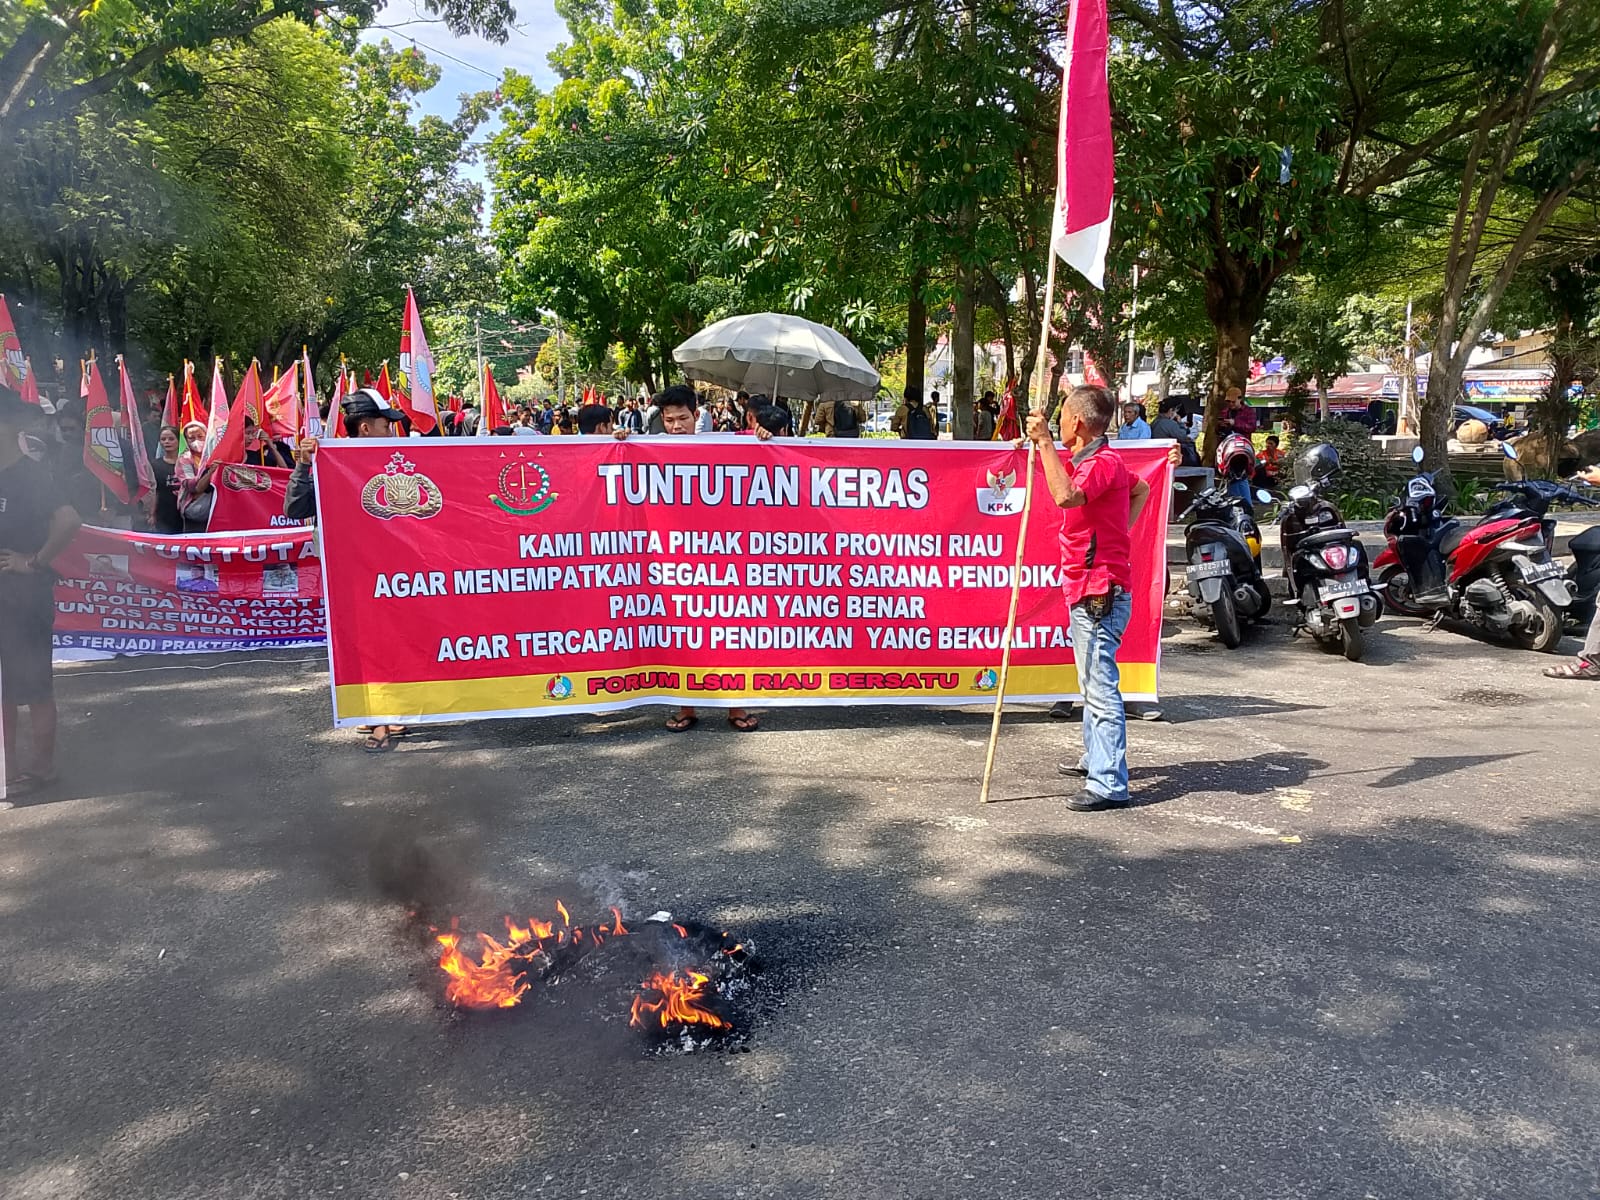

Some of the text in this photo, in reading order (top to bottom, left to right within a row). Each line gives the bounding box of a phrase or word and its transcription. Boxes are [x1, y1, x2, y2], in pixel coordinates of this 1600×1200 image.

[598, 464, 930, 510] TUNTUTAN KERAS
[987, 502, 1013, 512] KPK
[519, 530, 1003, 559] KAMI MINTA PIHAK DISDIK PROVINSI RIAU
[373, 571, 448, 599] AGAR
[453, 562, 641, 595] MENEMPATKAN
[647, 562, 740, 587] SEGALA
[746, 563, 843, 587] BENTUK
[848, 564, 943, 588] SARANA
[85, 592, 174, 609] (POLDA
[218, 598, 312, 608] APARAT
[609, 594, 926, 619] PADA TUJUAN YANG BENAR
[55, 602, 142, 618] UNTAS
[150, 610, 234, 625] SEMUA
[103, 617, 177, 632] DINAS
[80, 636, 156, 651] TERJADI
[162, 639, 246, 650] PRAKTEK
[437, 634, 510, 662] AGAR
[515, 627, 634, 656] TERCAPAI
[638, 625, 703, 649] MUTU
[710, 626, 853, 650] PENDIDIKAN
[866, 626, 931, 650] YANG
[587, 672, 960, 695] FORUM LSM RIAU BERSATU
